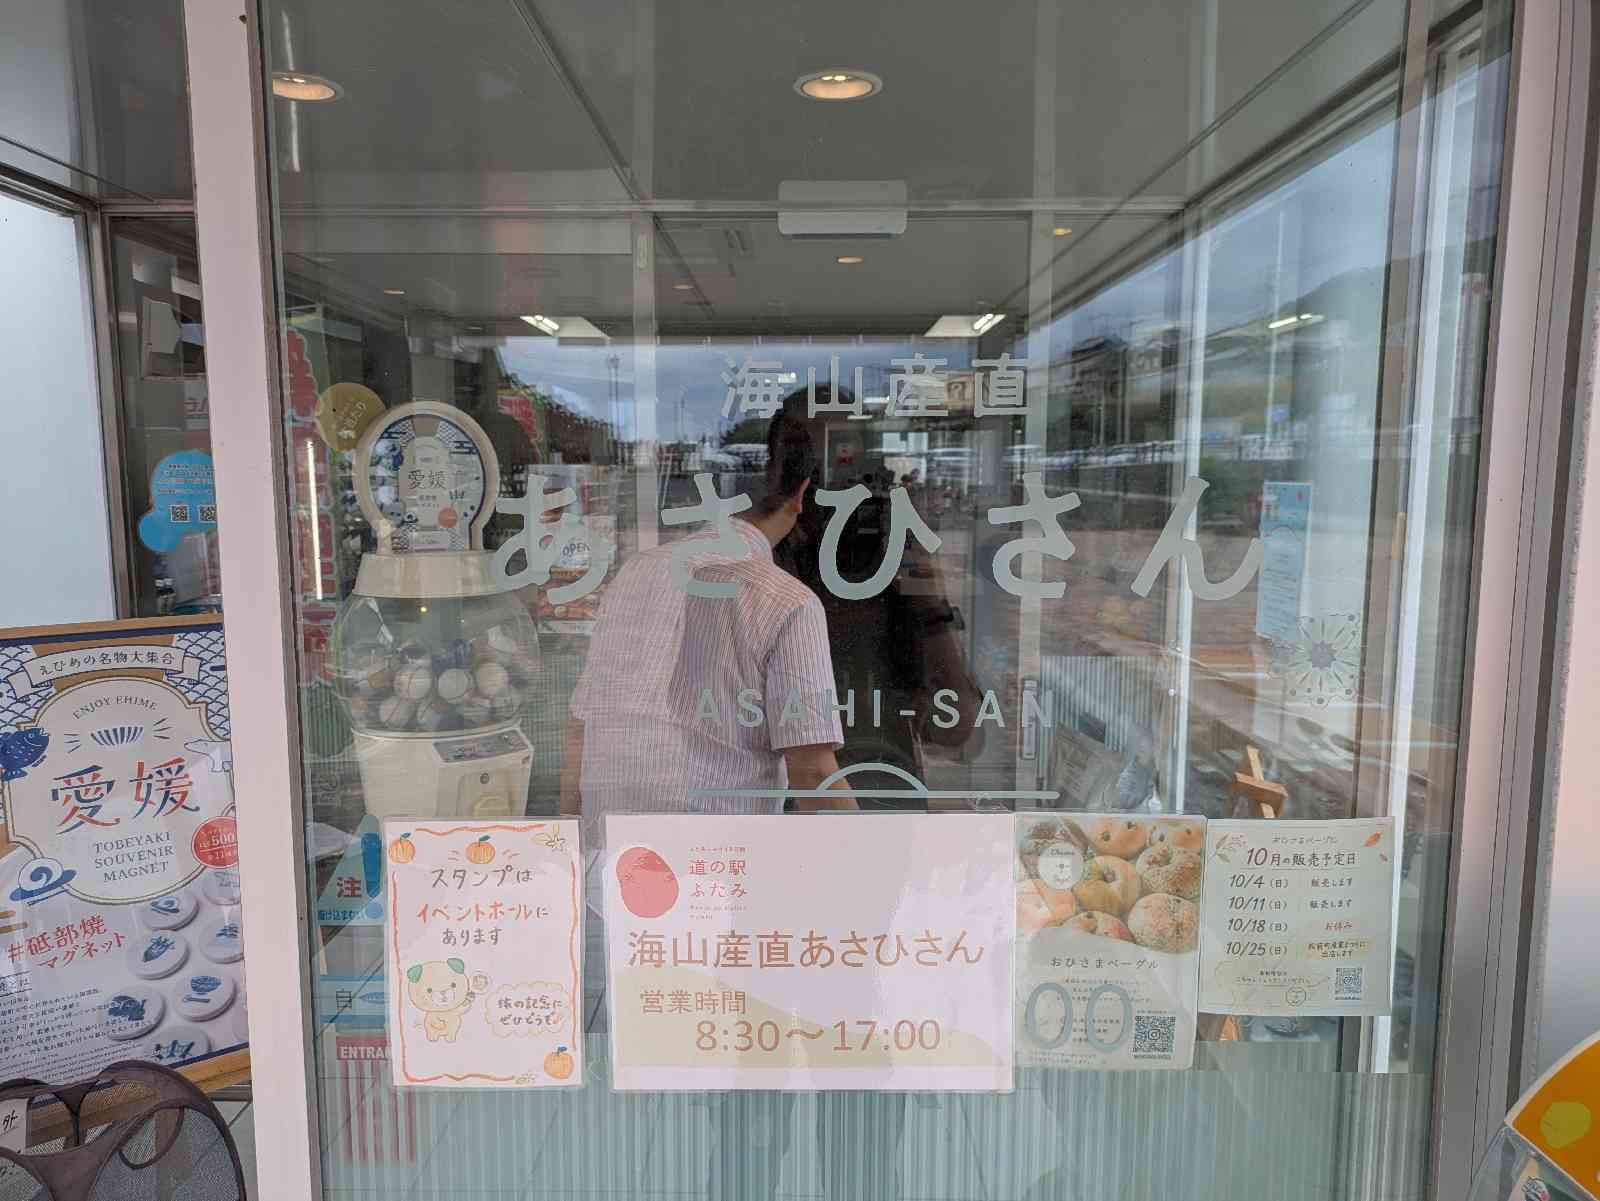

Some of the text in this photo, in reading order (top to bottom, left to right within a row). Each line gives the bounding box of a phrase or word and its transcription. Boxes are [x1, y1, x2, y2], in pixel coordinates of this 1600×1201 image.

[722, 352, 1030, 420] 海山産直
[408, 470, 447, 489] 愛媛
[490, 471, 1263, 605] あさひさん
[72, 695, 157, 720] ENJOY EHIME
[694, 687, 1054, 729] ASAHI-SAN
[51, 756, 200, 835] 愛媛
[93, 831, 171, 853] TOBEYAKI
[94, 845, 175, 869] SOUVENIR
[689, 859, 747, 876] 道の駅
[103, 861, 169, 882] MAGNET
[431, 864, 533, 890] スタンプは
[690, 882, 748, 898] ふたみ
[417, 901, 549, 923] イベントホールに
[442, 928, 502, 947] あります
[628, 929, 984, 969] 海山産直あさひさん
[36, 932, 126, 969] マグネット
[1050, 956, 1159, 969] おひさまベーグル
[639, 989, 747, 1016] 営業時間
